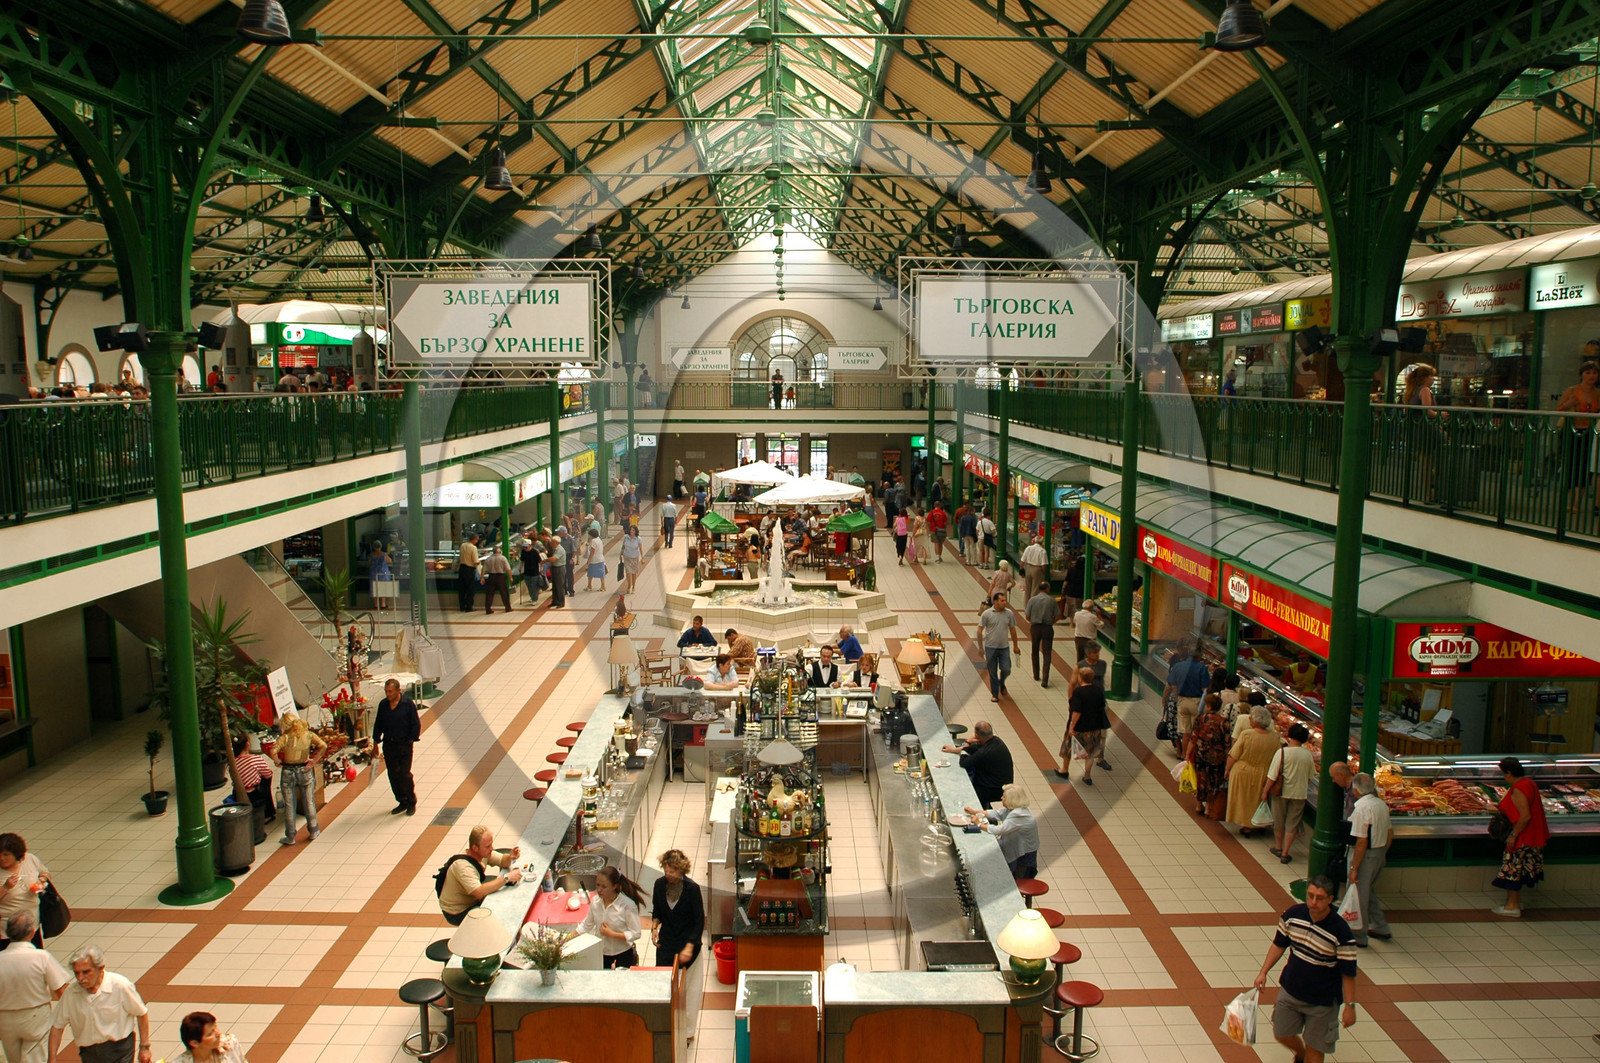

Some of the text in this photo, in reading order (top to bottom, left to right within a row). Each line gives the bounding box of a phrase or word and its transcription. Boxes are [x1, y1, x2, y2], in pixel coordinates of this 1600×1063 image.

[442, 289, 560, 307] ЗАВЕДЕНИЯ
[953, 297, 1075, 315] ТЪРГОВСКА
[488, 313, 513, 329] ЗА
[970, 322, 1057, 338] ГАЛЕРИЯ
[420, 337, 585, 353] БЪРЗО ХРАНЕНЕ
[1088, 509, 1109, 537] PAIN
[1251, 589, 1330, 642] KAROL-FERNANDEZ M
[1419, 639, 1473, 655] КФМ
[1486, 640, 1583, 660] КАРОЛ-Ф
